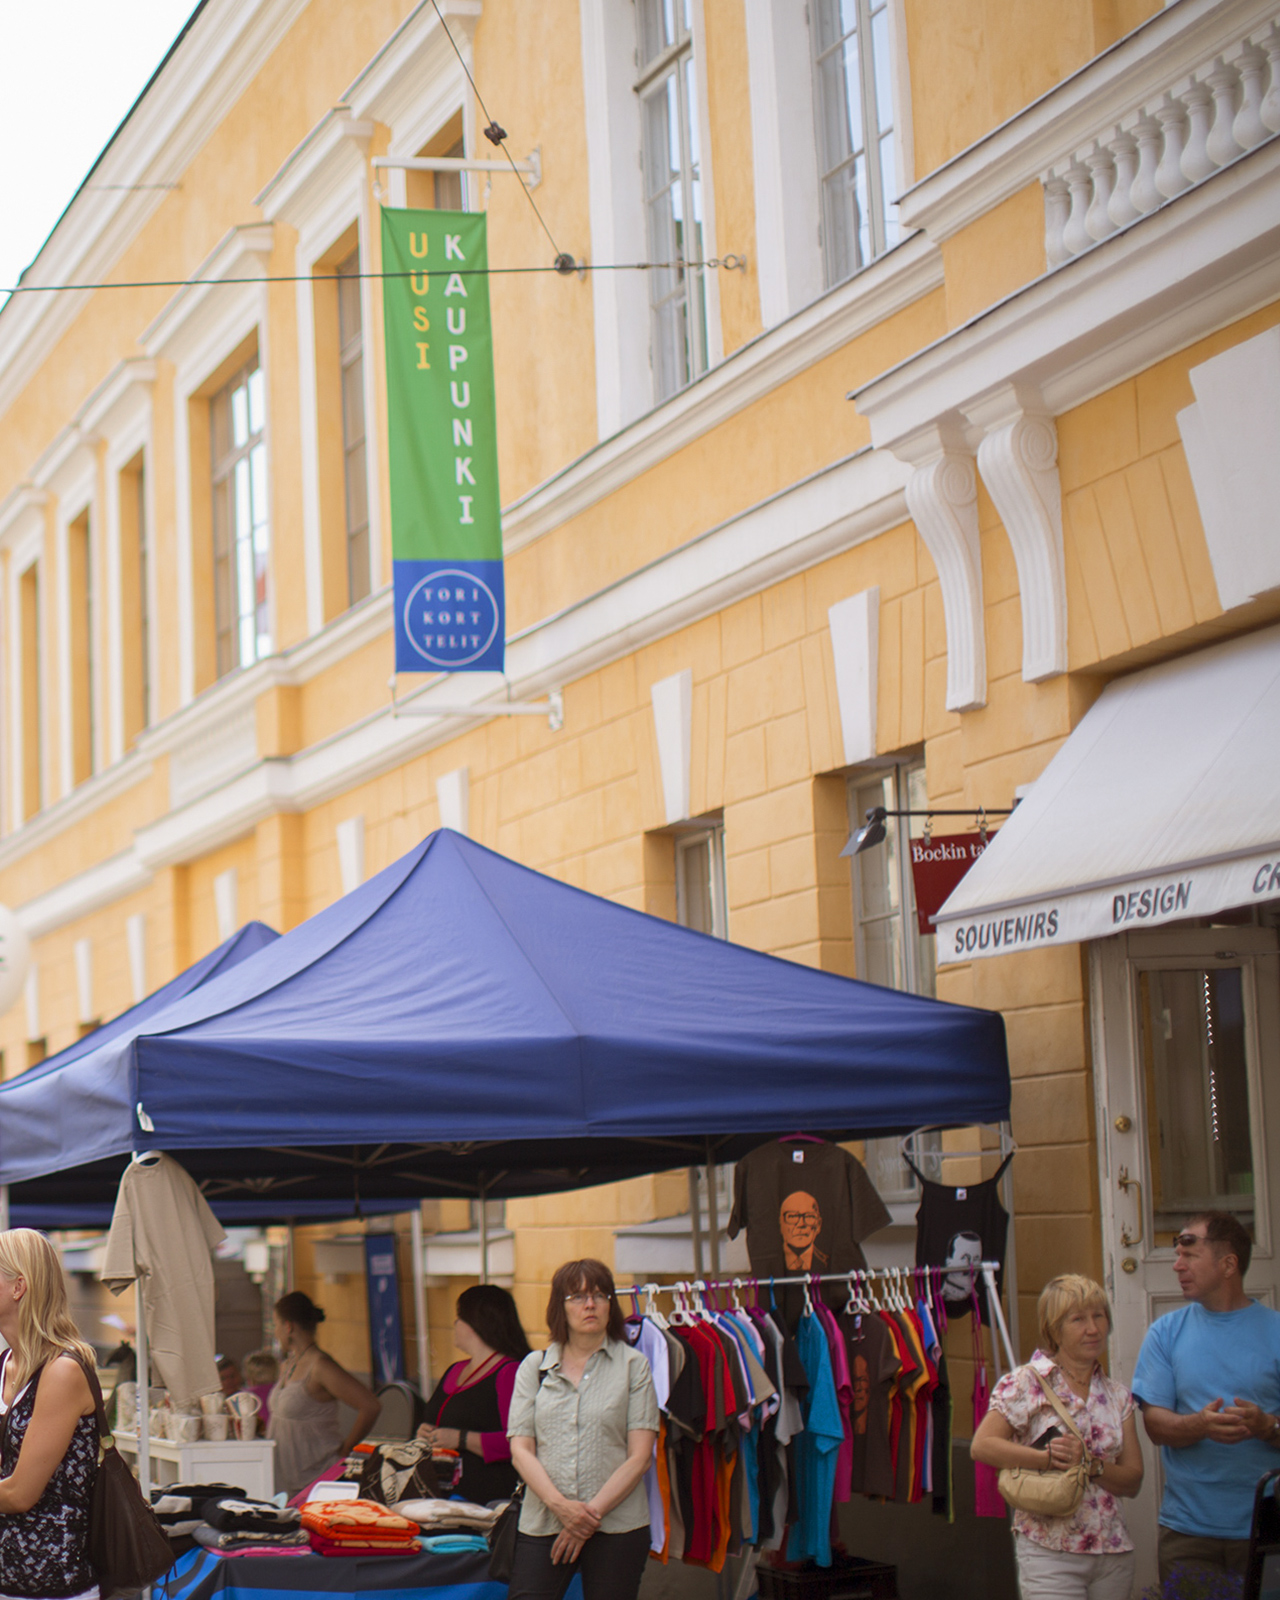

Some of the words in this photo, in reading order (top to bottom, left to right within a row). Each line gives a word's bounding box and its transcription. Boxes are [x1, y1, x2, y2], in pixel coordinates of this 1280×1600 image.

[410, 232, 431, 369] UUSI
[444, 234, 476, 524] KAUPUNKI
[423, 588, 478, 602] TORI
[423, 611, 481, 625] KORT
[423, 635, 481, 648] TELIT
[912, 843, 967, 863] Bockin
[954, 910, 1060, 954] SOUVENIRS
[1113, 880, 1193, 925] DESIGN
